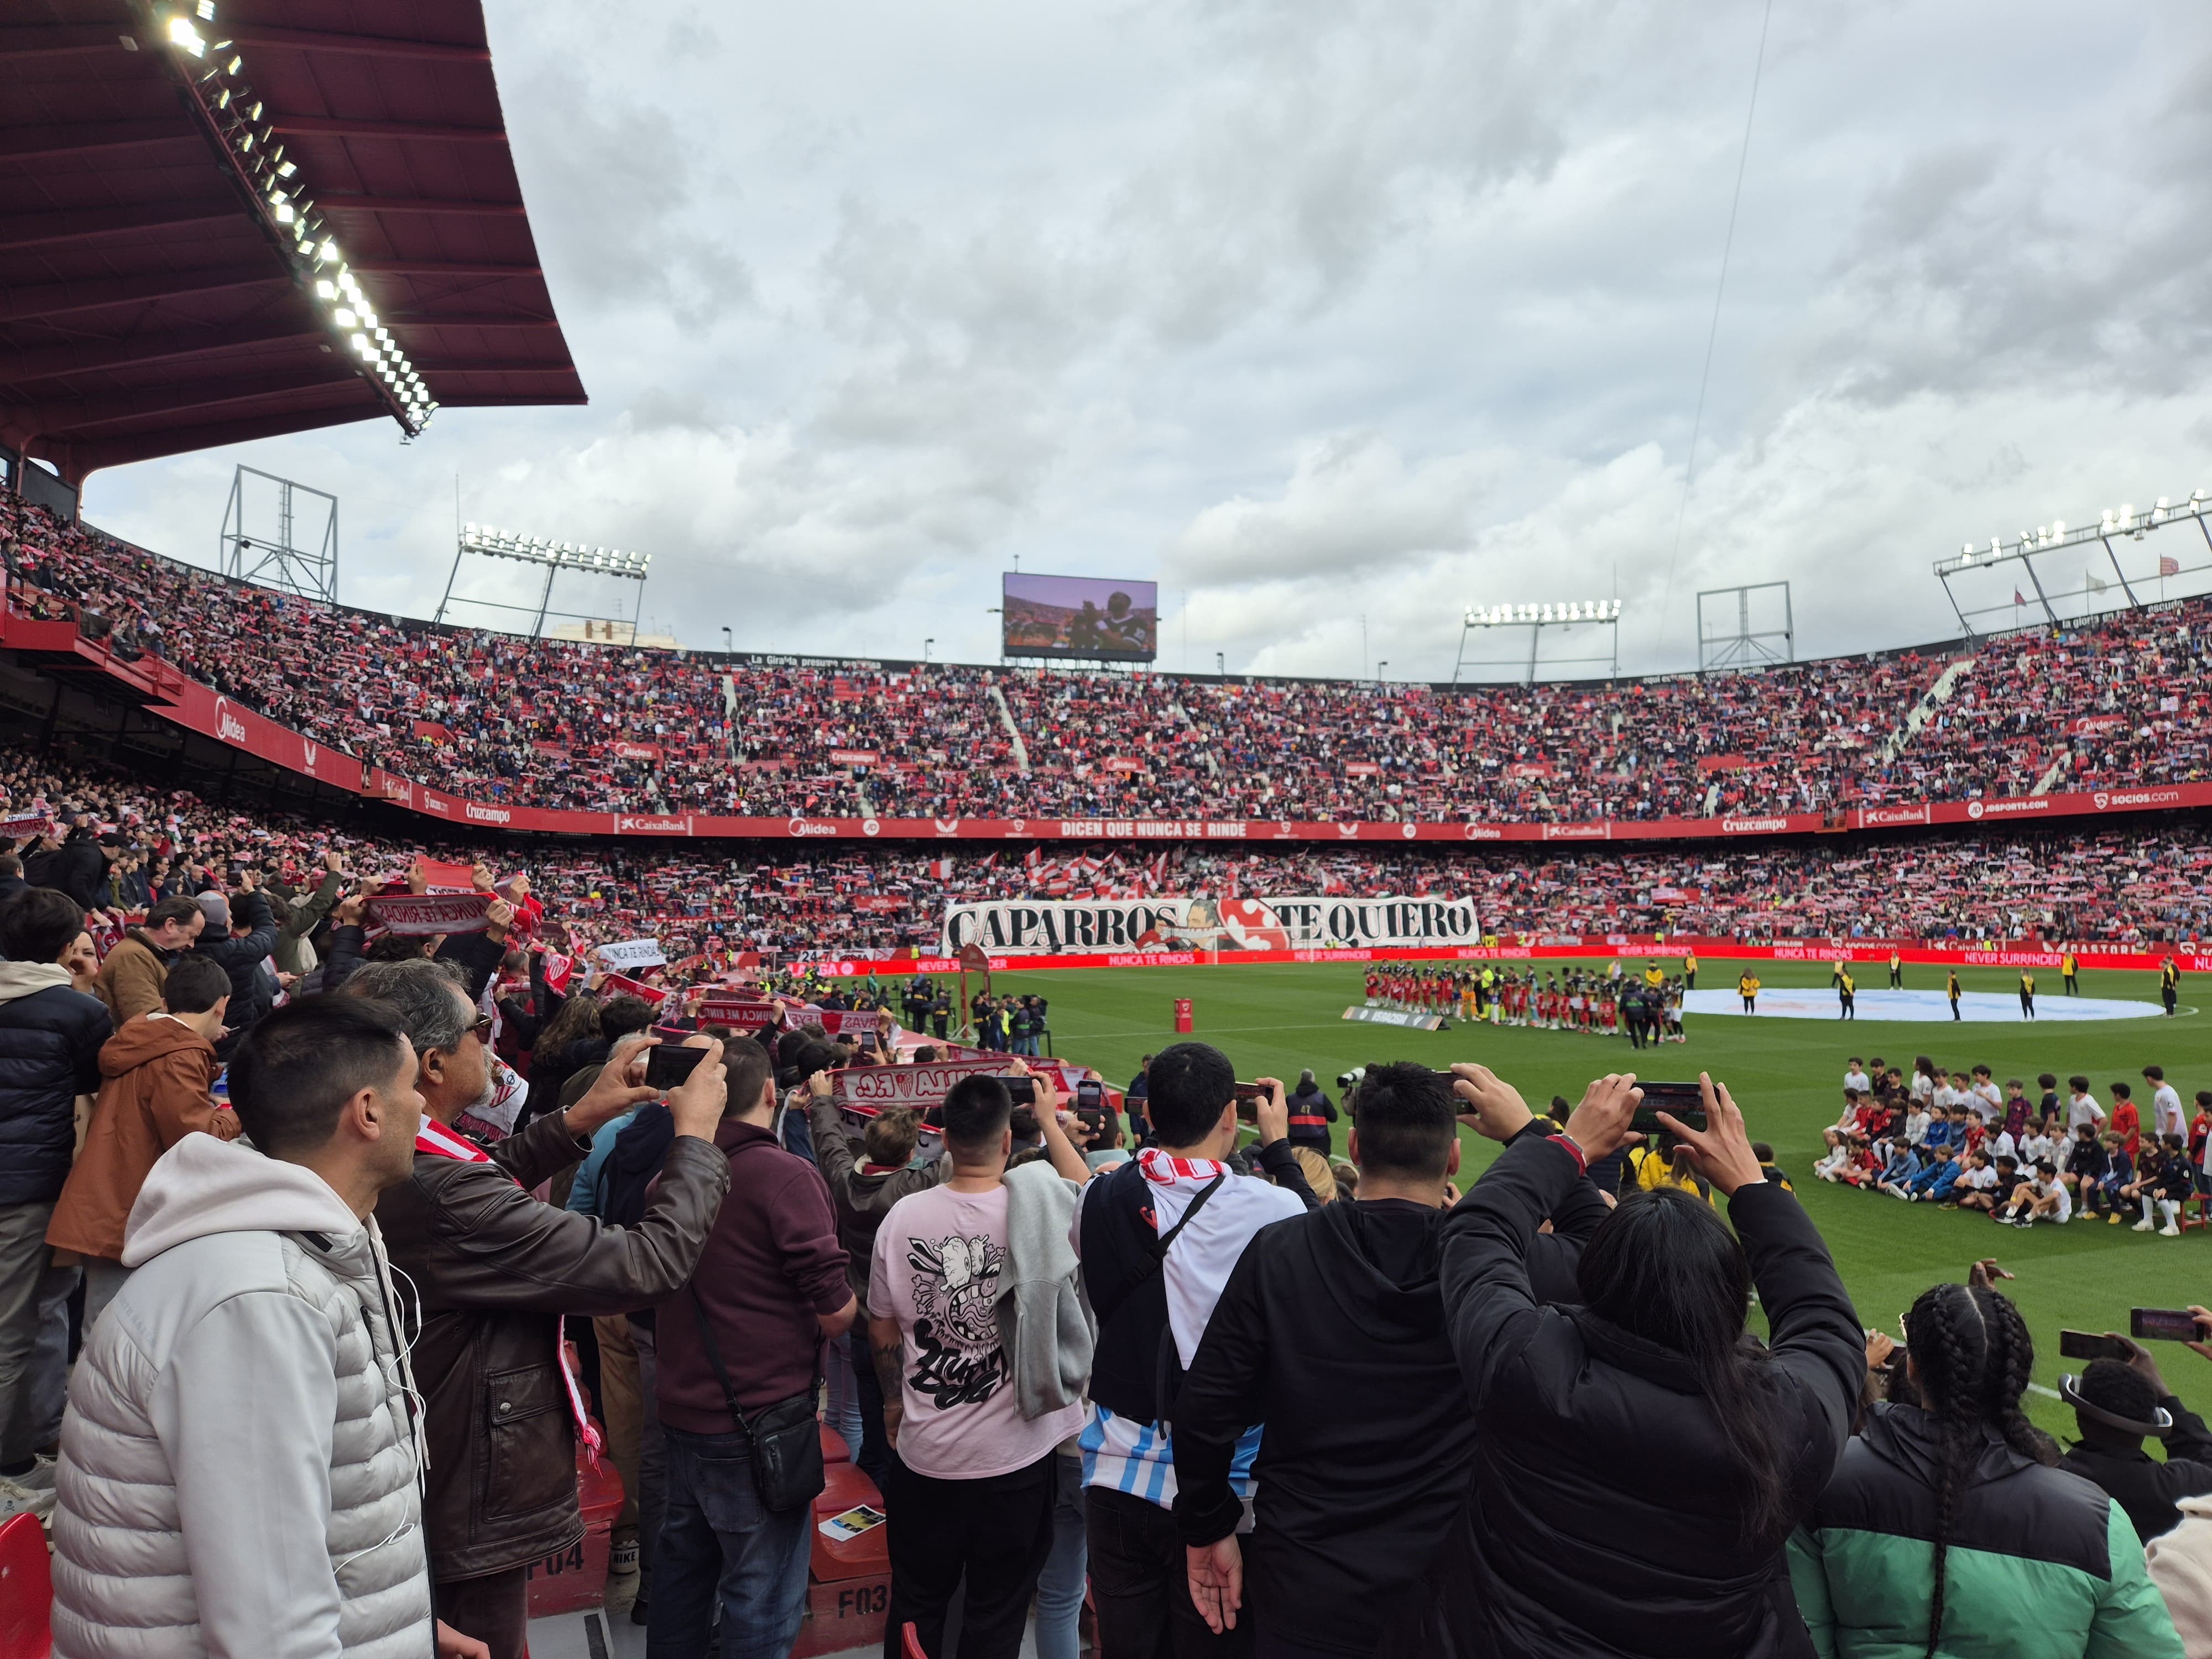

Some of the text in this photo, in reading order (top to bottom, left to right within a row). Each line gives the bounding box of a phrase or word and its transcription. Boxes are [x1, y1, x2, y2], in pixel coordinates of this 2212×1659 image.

[2062, 619, 2071, 629] la
[2073, 614, 2100, 629] gloria
[751, 654, 762, 664] La
[766, 655, 797, 665] Giralda
[218, 710, 246, 742] Midea
[620, 746, 652, 758] Midea
[831, 752, 875, 763] Cruzcampo
[466, 802, 510, 824] Cruzcampo
[1984, 800, 2048, 813] JDSPORTS.COM
[1879, 808, 1924, 823] CaixaBank
[635, 818, 686, 831] CaixaBank
[794, 822, 836, 835] Midea
[1061, 822, 1247, 838] DICEN QUE NUNCA SE RINDE
[1723, 818, 1787, 832] Cruzcampo
[1472, 826, 1501, 838] Midea
[947, 905, 1179, 948] CAPARROS
[1273, 902, 1473, 948] TE QUIERO
[629, 947, 638, 958] TE
[1457, 948, 1488, 958] NUNCA
[1488, 948, 1499, 958] TE
[1773, 947, 1853, 961] NUNCA TE RINDAS
[1965, 952, 2062, 966] NEVER SURRENDER
[1109, 953, 1195, 966] NUNCA TE RINDAS
[791, 962, 838, 977] LAGA
[917, 961, 950, 972] NEVER
[1301, 1105, 1311, 1114] 47
[613, 1551, 635, 1564] NIKE
[838, 1584, 888, 1619] F03
